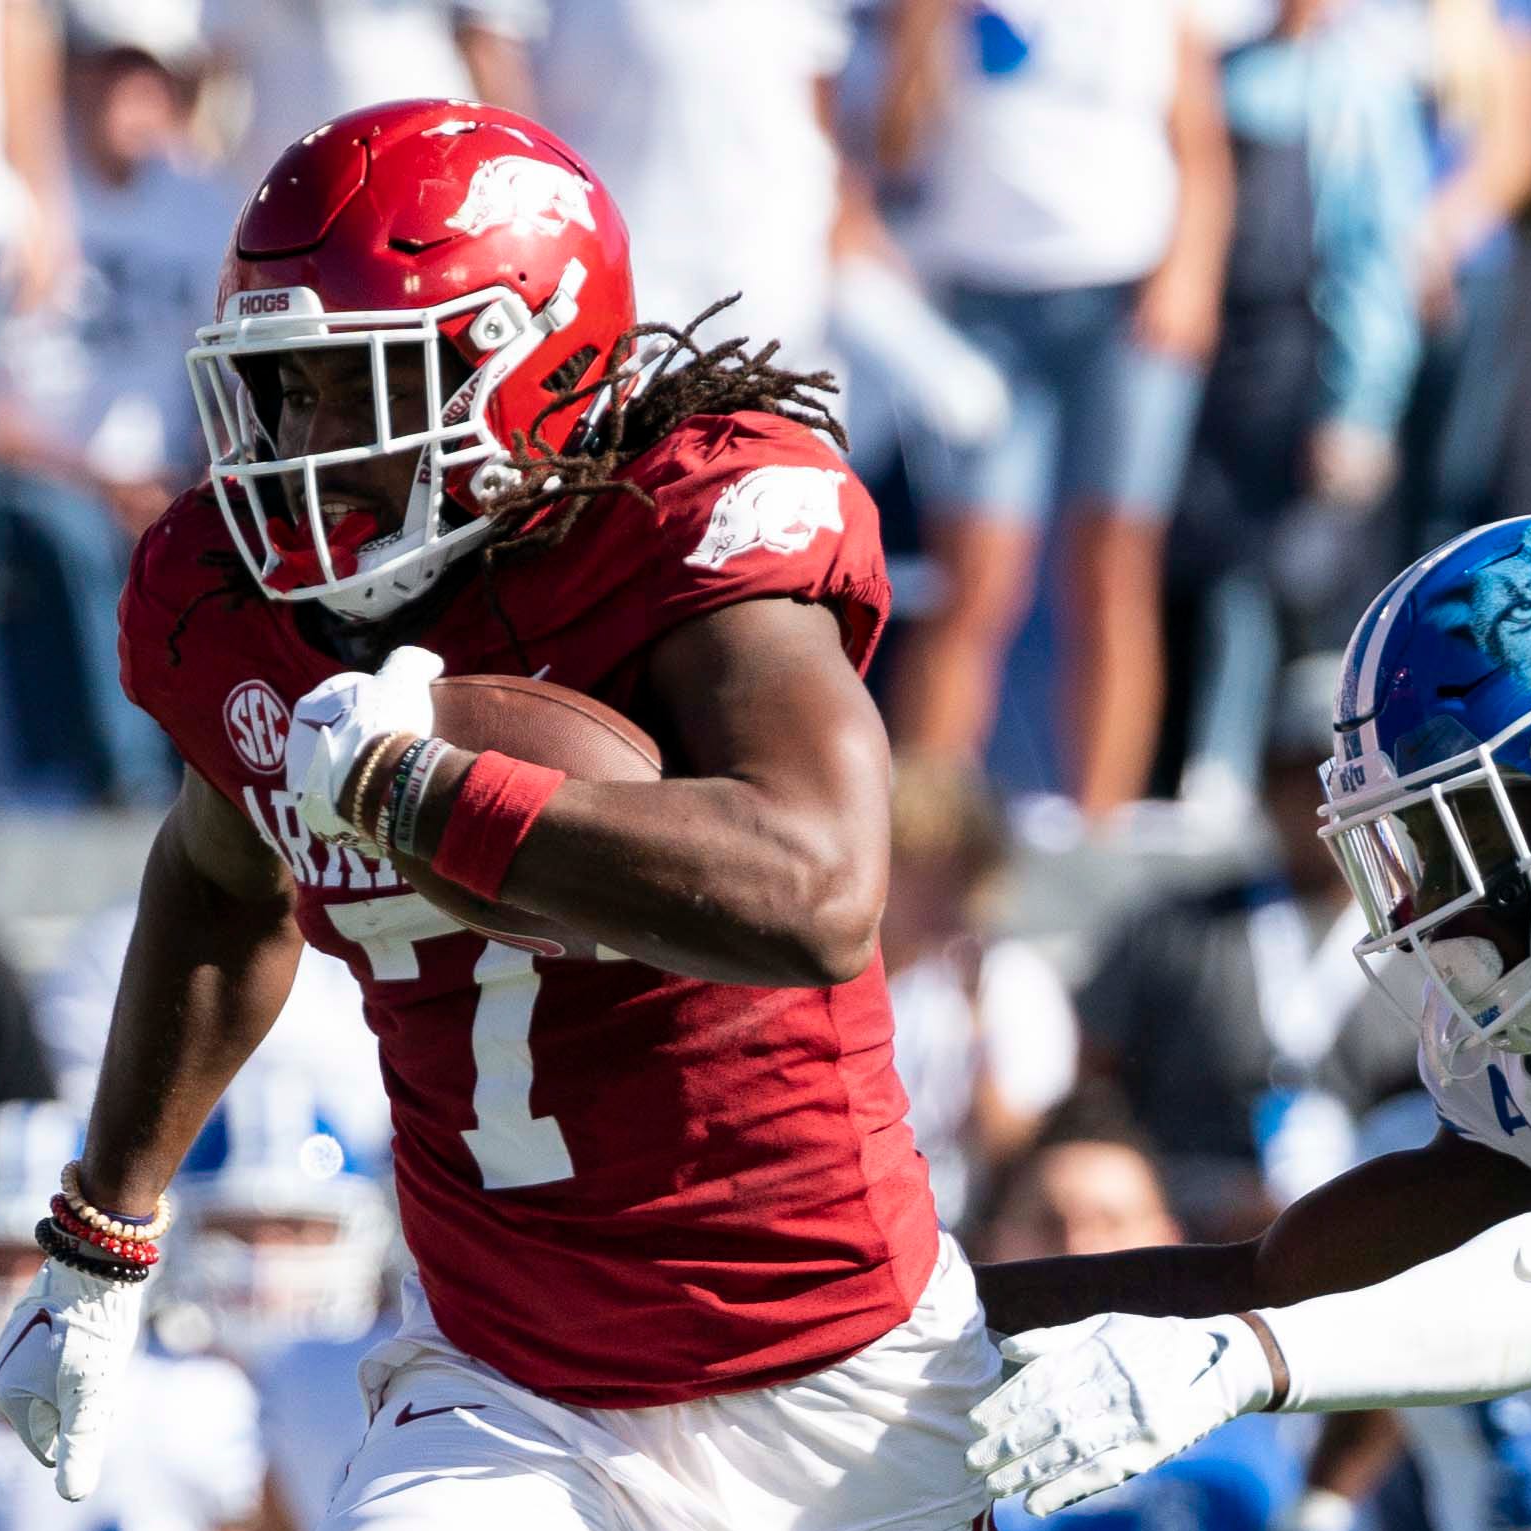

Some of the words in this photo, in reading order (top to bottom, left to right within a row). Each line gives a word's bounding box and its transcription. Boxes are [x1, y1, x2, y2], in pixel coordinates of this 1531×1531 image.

[238, 292, 290, 316] HOGS
[230, 688, 286, 767] SEC
[1339, 763, 1367, 793] BYU
[324, 892, 632, 1190] 7
